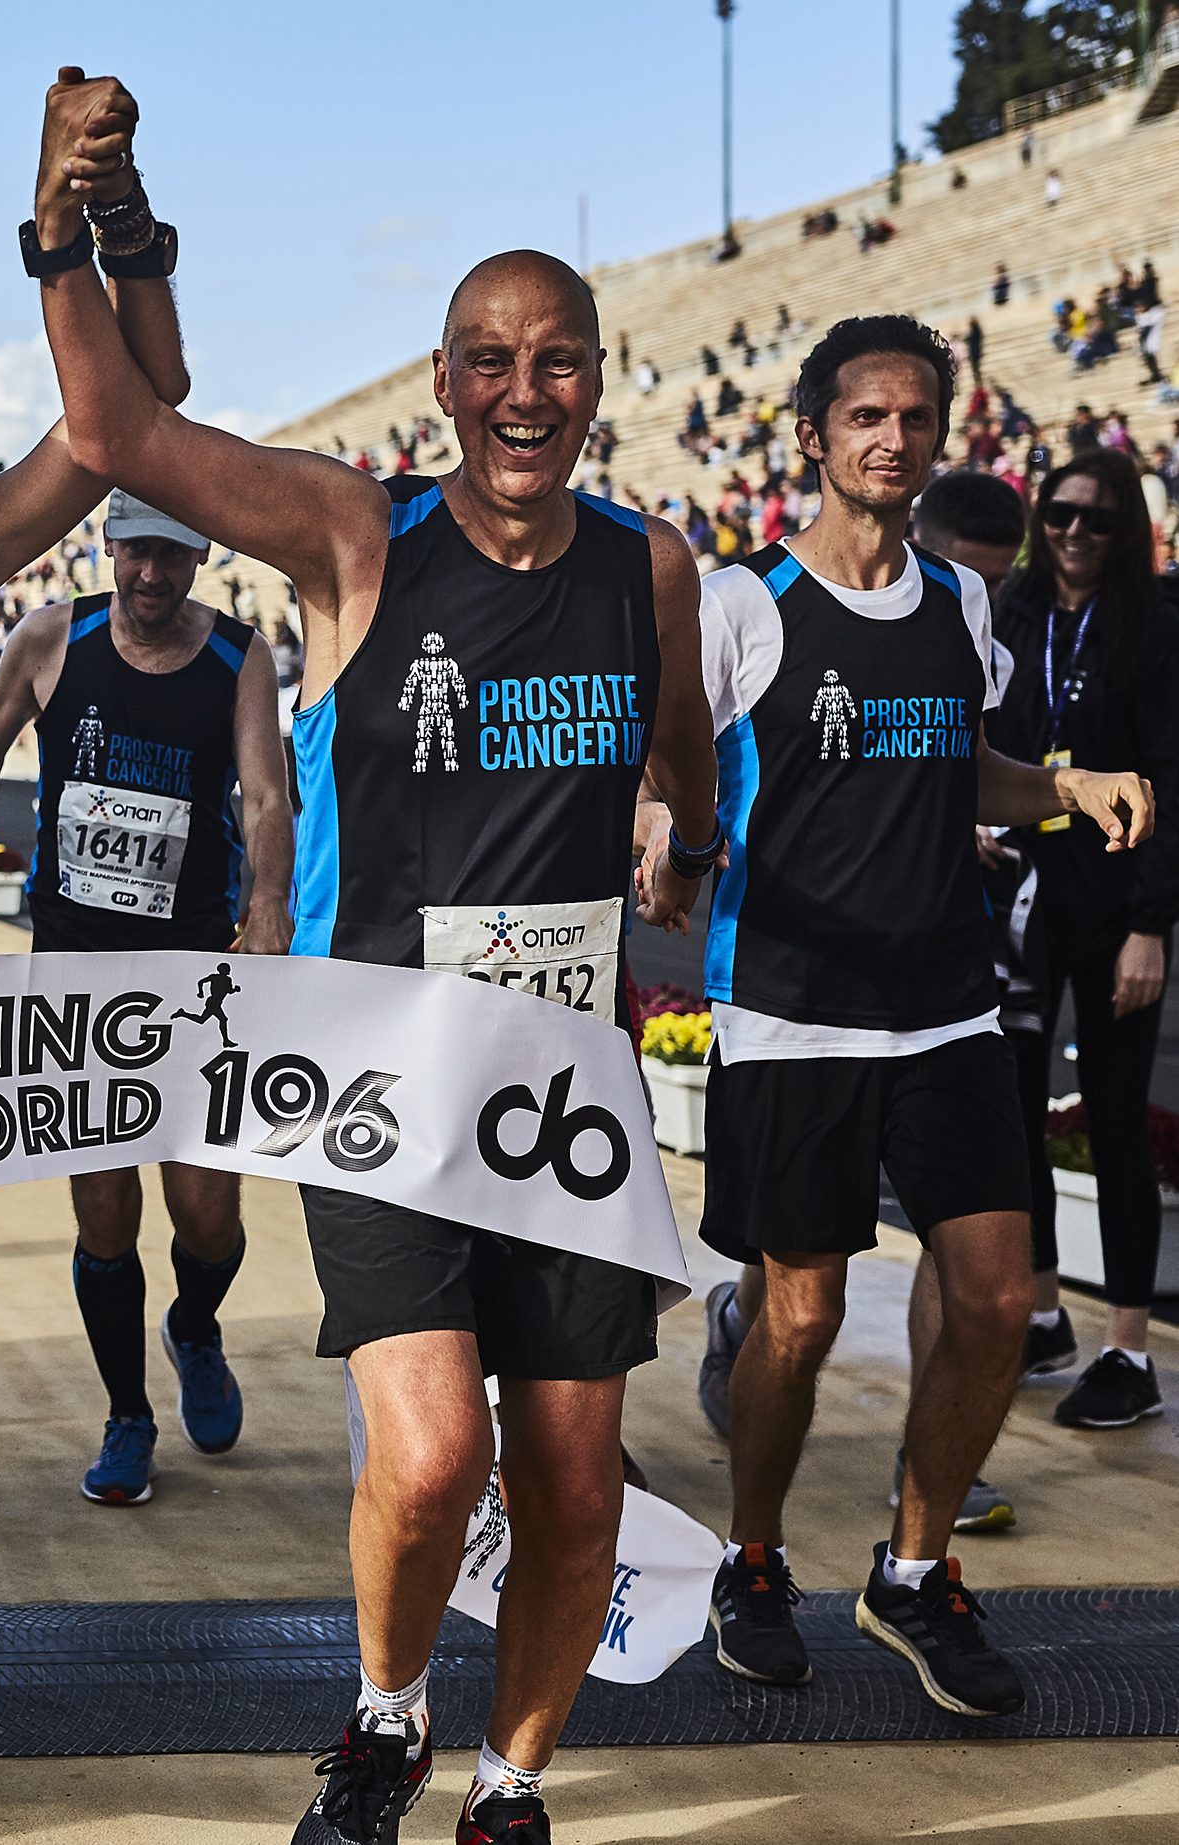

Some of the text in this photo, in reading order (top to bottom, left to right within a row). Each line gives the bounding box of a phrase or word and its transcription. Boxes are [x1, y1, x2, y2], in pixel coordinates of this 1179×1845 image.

[479, 674, 639, 724] PROSTATE
[863, 697, 966, 728] PROSTATE
[109, 734, 194, 773] PROSTATE
[479, 721, 646, 771] CANCER UK
[861, 728, 972, 758] CANCER UK
[106, 758, 192, 797] CANCER UK
[75, 824, 168, 871] 16414
[467, 963, 595, 1012] 152
[198, 1049, 404, 1173] 196
